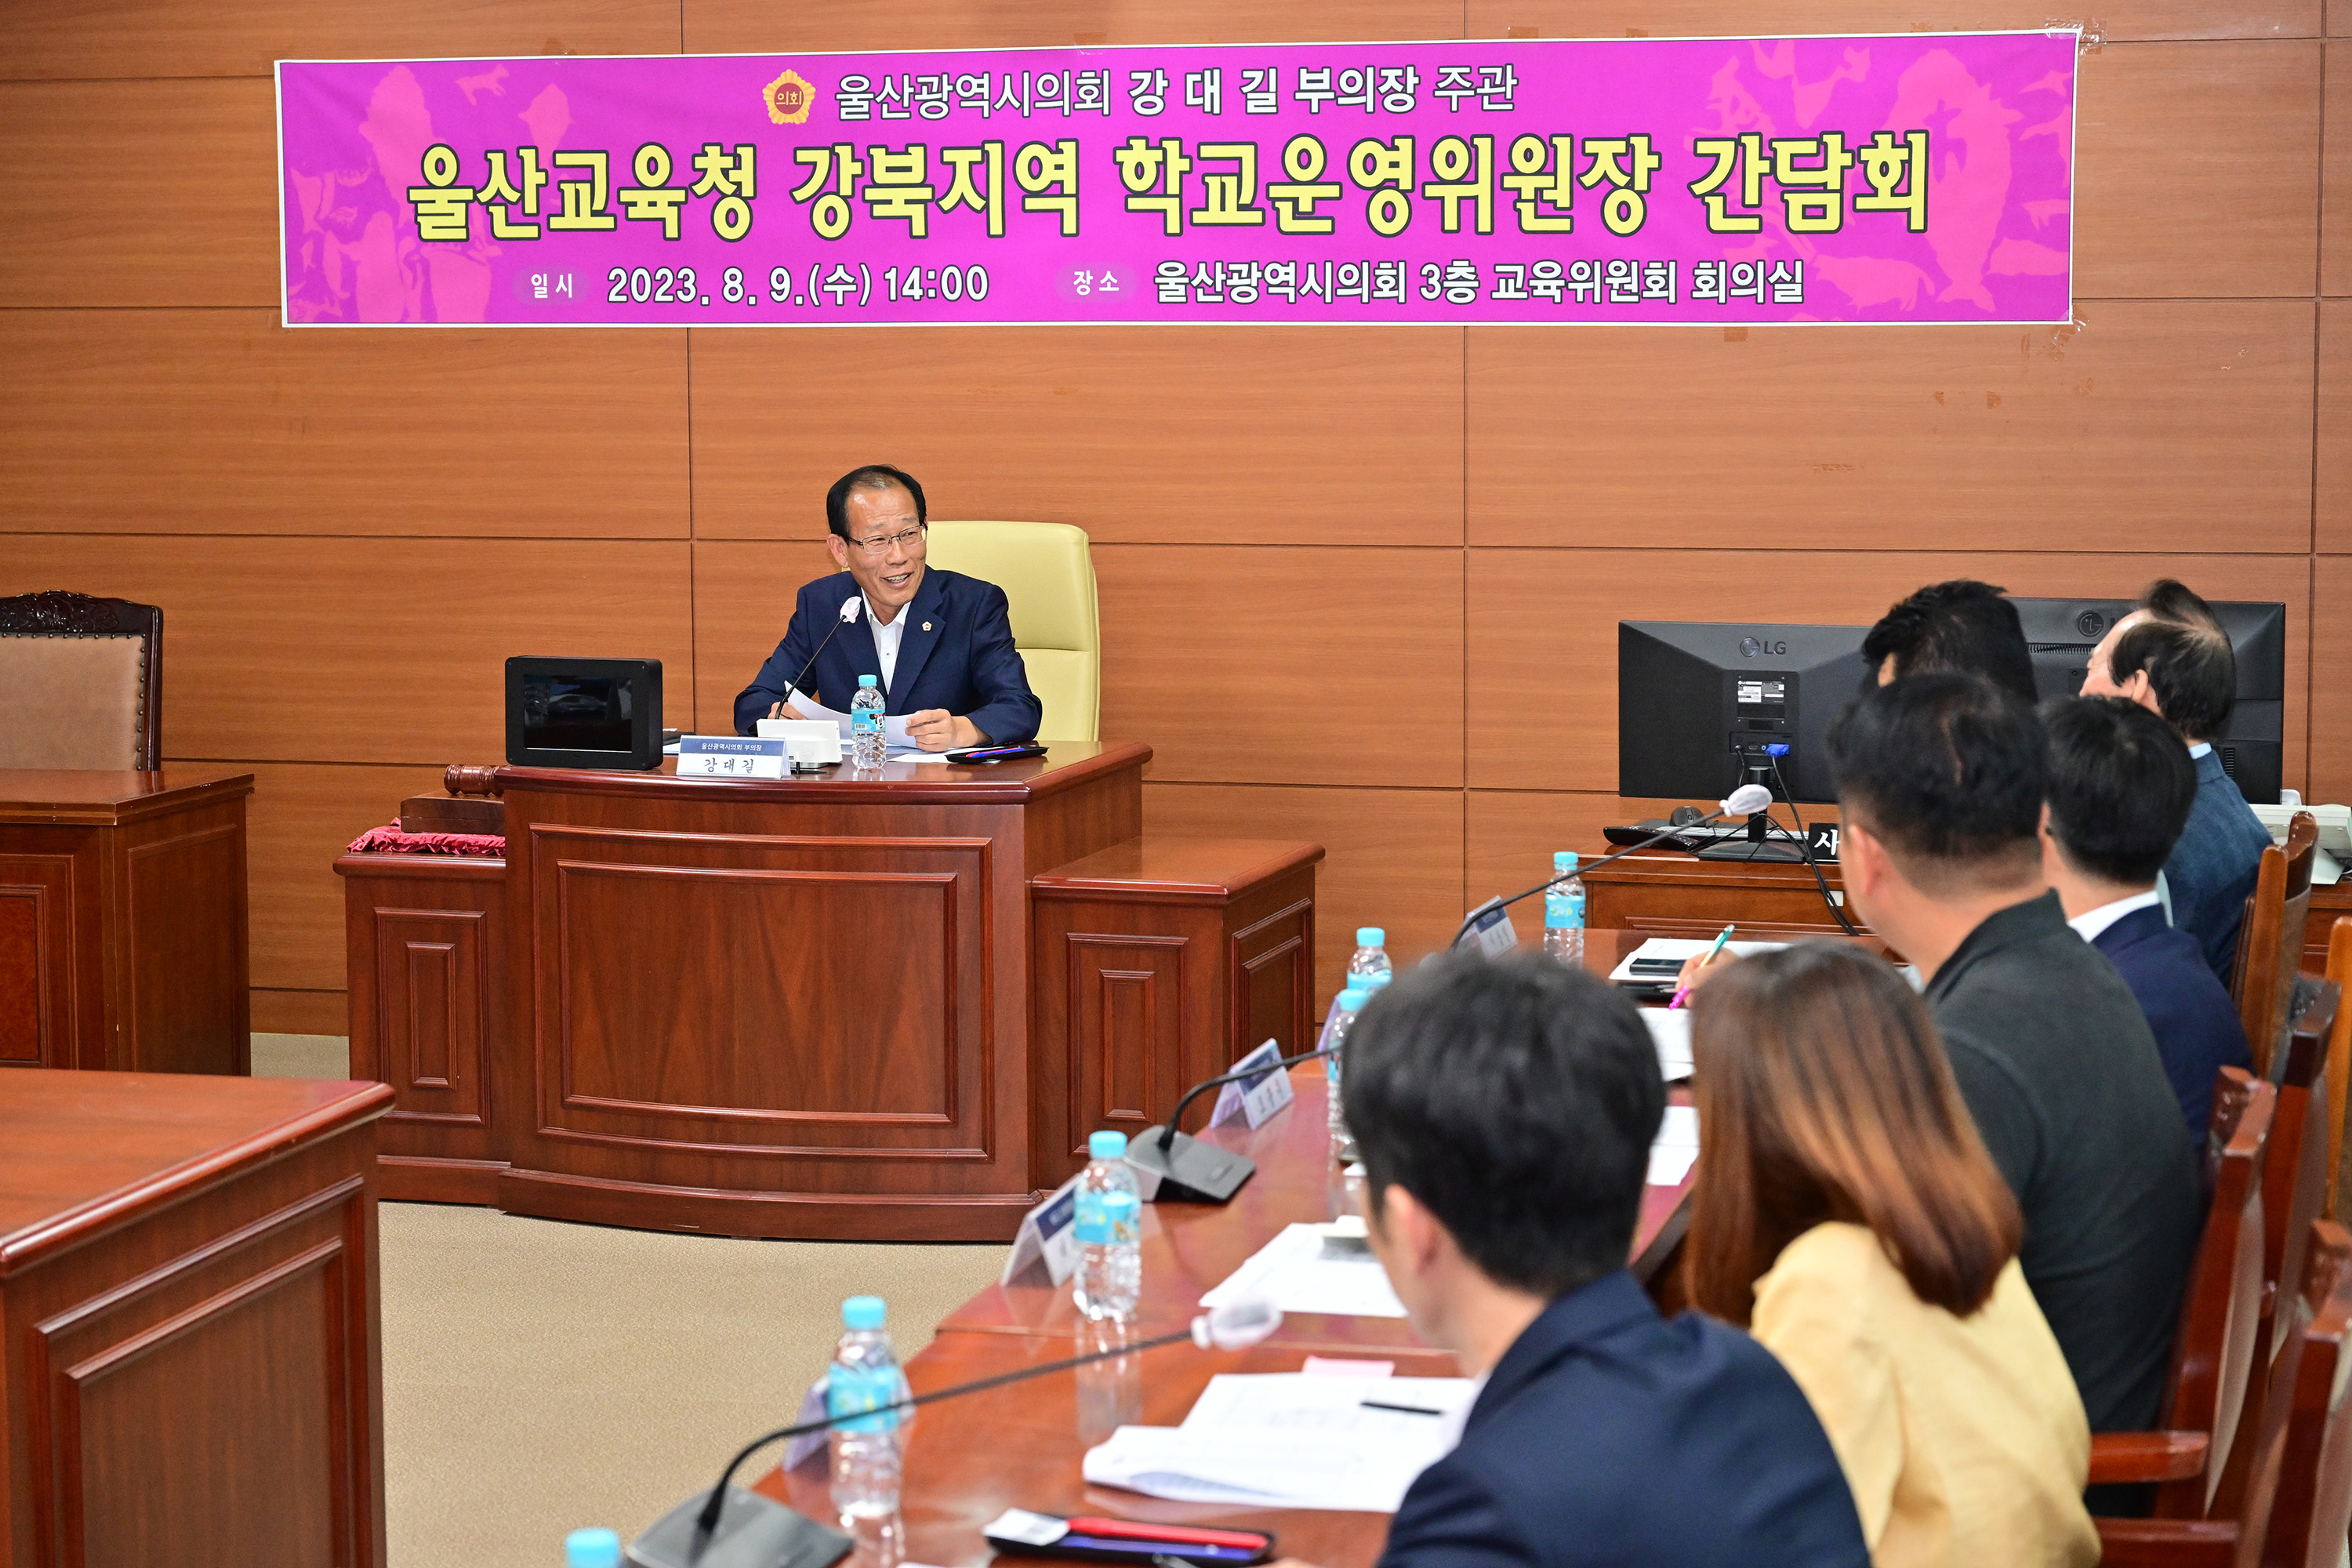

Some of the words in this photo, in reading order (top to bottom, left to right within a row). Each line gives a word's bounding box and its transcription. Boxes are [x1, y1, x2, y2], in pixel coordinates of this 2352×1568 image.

[775, 90, 803, 106] 의회
[835, 69, 1110, 119] 울산광역시의회
[1294, 65, 1421, 114] 부의장
[1433, 64, 1519, 113] 주관
[407, 142, 757, 242] 울산교육청
[789, 138, 1080, 241] 강북지역
[1113, 133, 1662, 238] 학교운영위원장
[1687, 129, 1929, 234] 간담회
[608, 267, 710, 306] 2023.
[722, 267, 757, 306] 8.
[884, 264, 989, 302] 14:00
[1153, 260, 1406, 304] 울산광역시의회
[1419, 260, 1480, 305] 3층
[1490, 259, 1677, 304] 교육위원회
[1691, 259, 1805, 304] 회의실
[1764, 641, 1787, 655] LG
[701, 742, 742, 751] 울산광역시의회
[744, 743, 762, 752] 부의장
